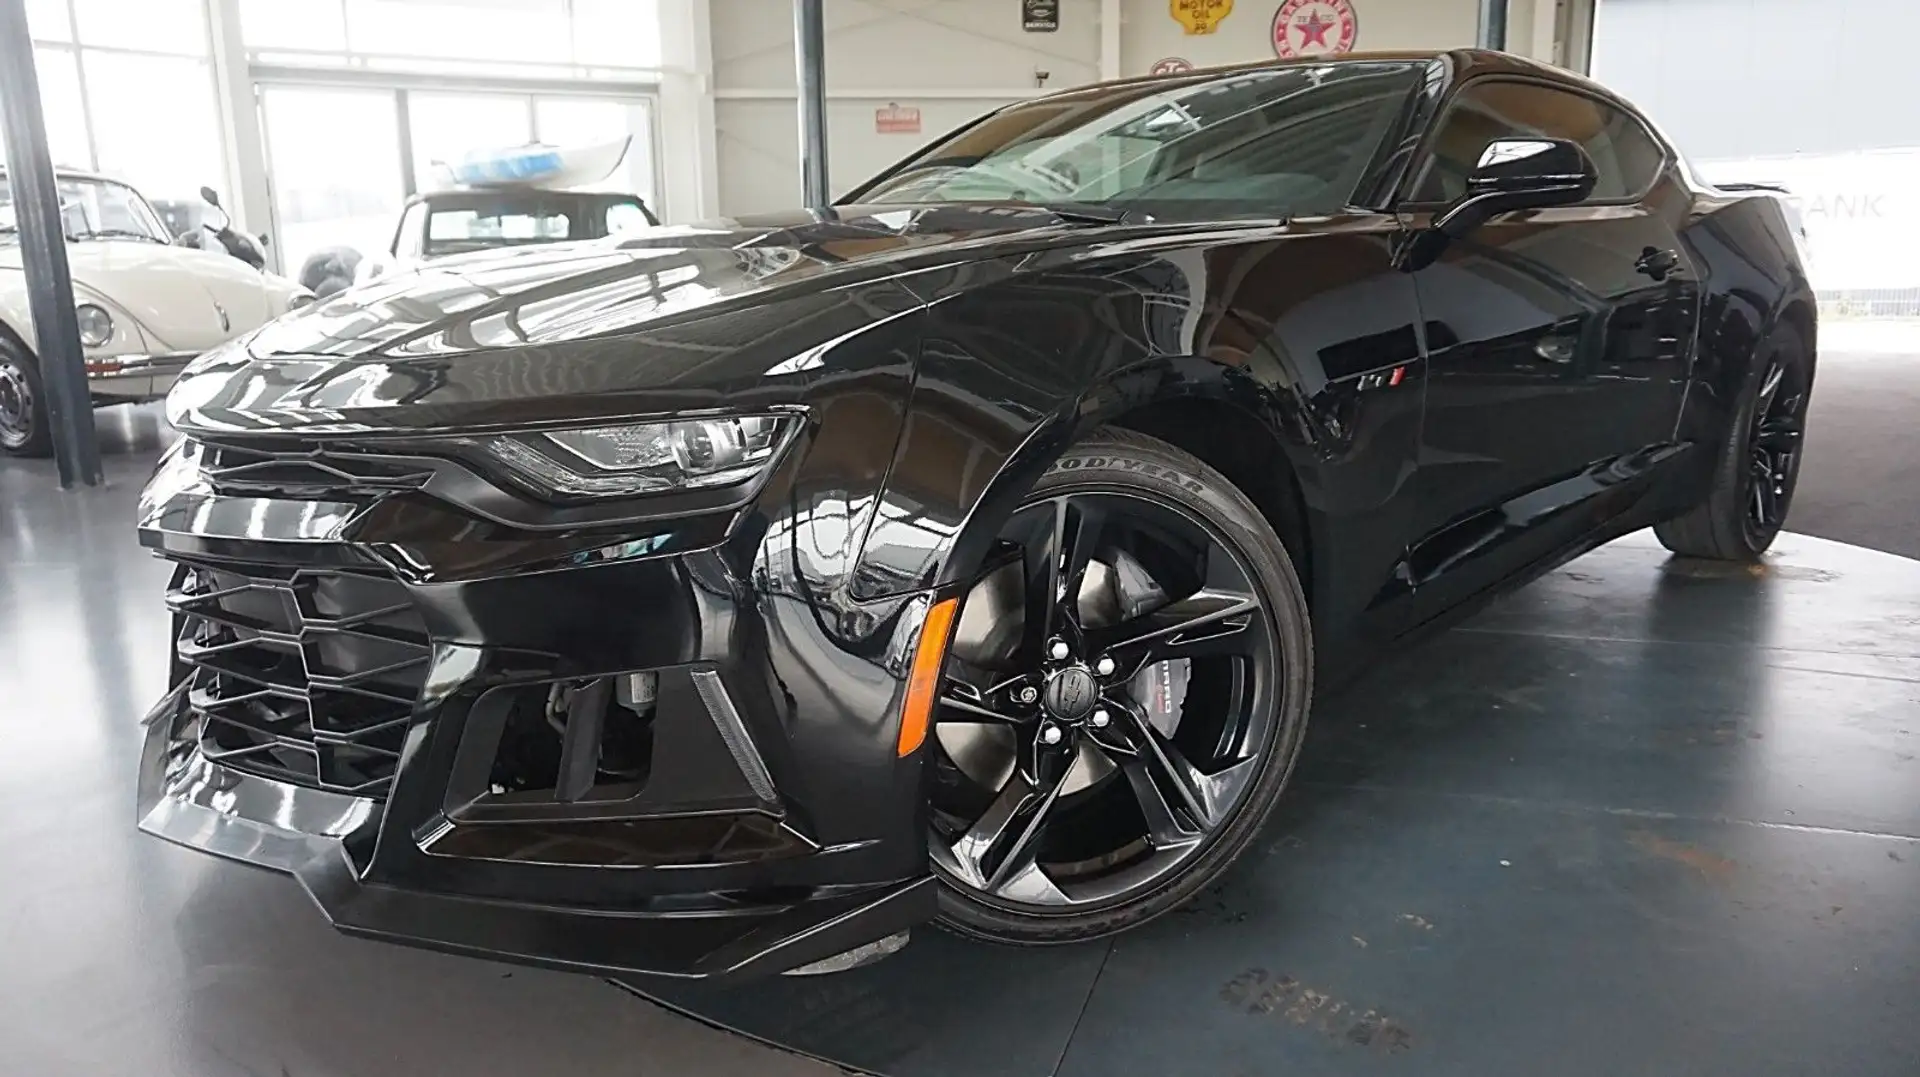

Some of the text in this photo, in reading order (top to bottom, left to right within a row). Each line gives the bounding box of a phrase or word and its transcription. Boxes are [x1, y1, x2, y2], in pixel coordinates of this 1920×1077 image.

[1179, 0, 1224, 11] MOTOR
[1192, 8, 1211, 20] OIL
[1297, 13, 1336, 23] TECO
[1798, 193, 1886, 219] ANK
